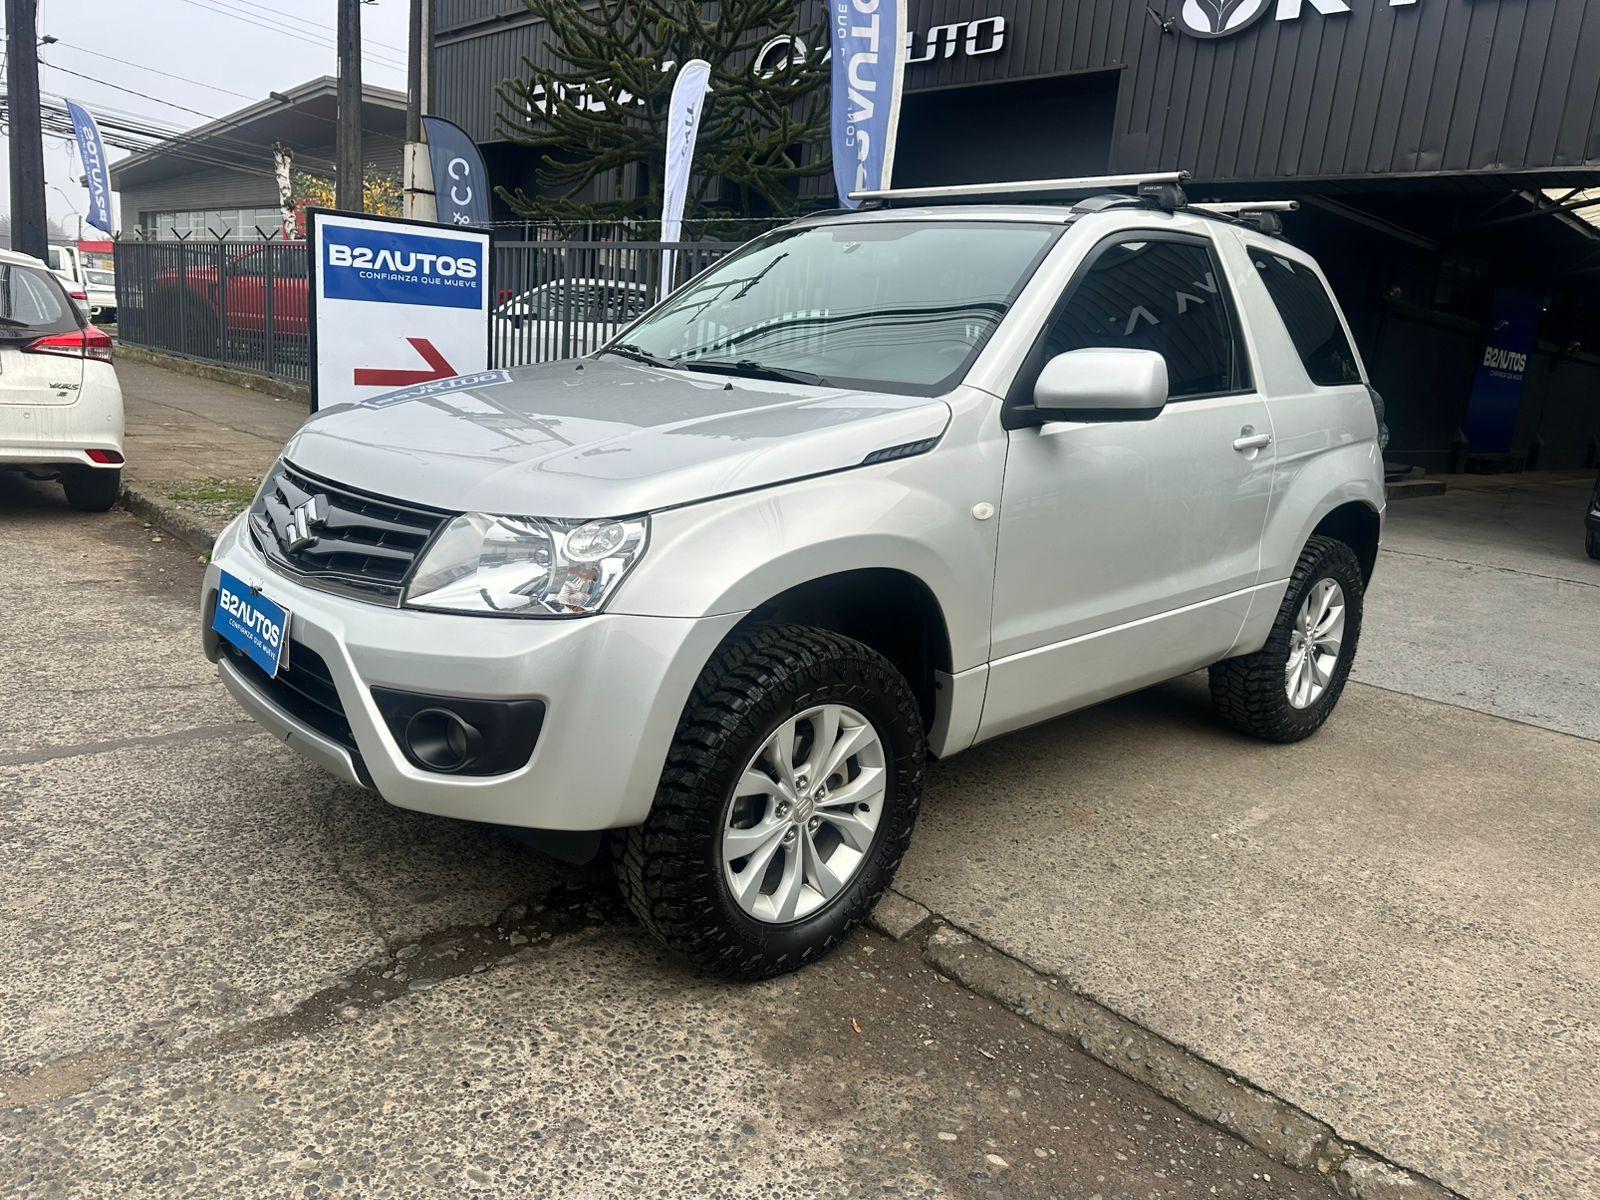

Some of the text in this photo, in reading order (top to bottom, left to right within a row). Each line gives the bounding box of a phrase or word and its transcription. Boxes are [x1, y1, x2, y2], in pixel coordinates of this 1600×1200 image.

[904, 16, 1005, 63] UTO
[329, 243, 477, 278] B2AUTOS
[359, 271, 477, 288] CONFIANZA QUE MUEVE
[1483, 346, 1527, 372] B2AUTOS
[220, 588, 280, 648] B2AUTOS
[229, 618, 276, 661] CONFIANZA QUE MUEVE
